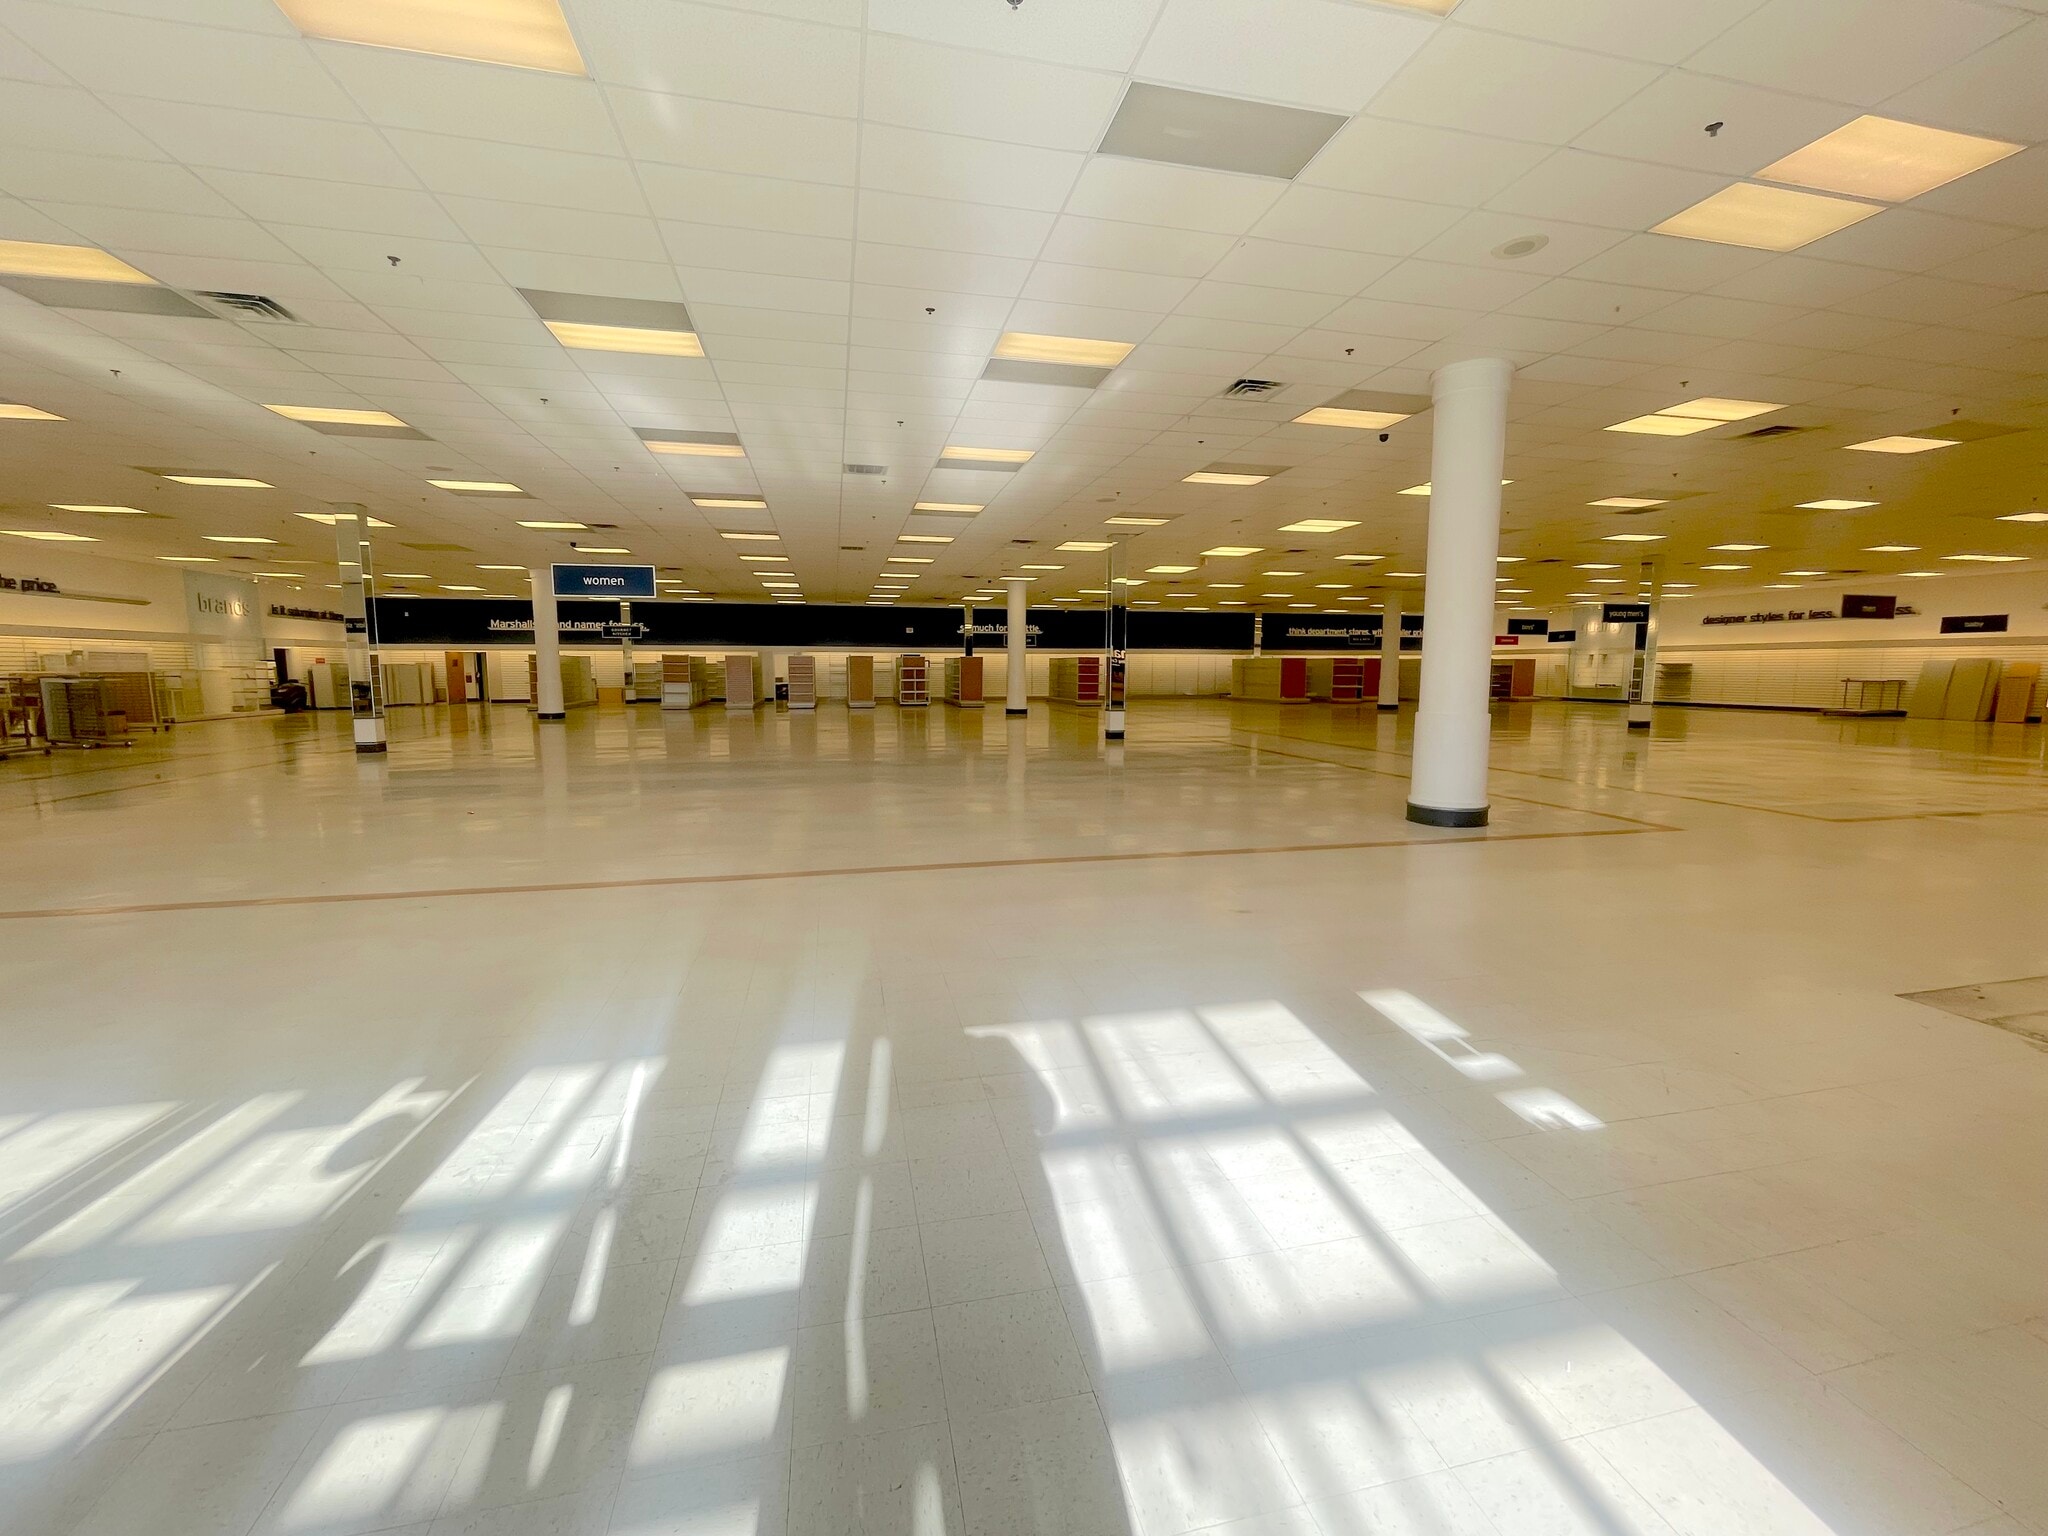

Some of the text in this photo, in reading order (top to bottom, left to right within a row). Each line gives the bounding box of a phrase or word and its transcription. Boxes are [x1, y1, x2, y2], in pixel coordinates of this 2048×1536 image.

[583, 577, 625, 586] women
[198, 592, 250, 617] brands
[1702, 615, 1747, 625] designer
[1750, 613, 1784, 624] styles
[1788, 610, 1805, 621] for
[574, 621, 606, 629] names
[973, 624, 994, 632] much
[1288, 627, 1306, 636] think
[1307, 627, 1347, 637] department
[1372, 628, 1383, 636] wit
